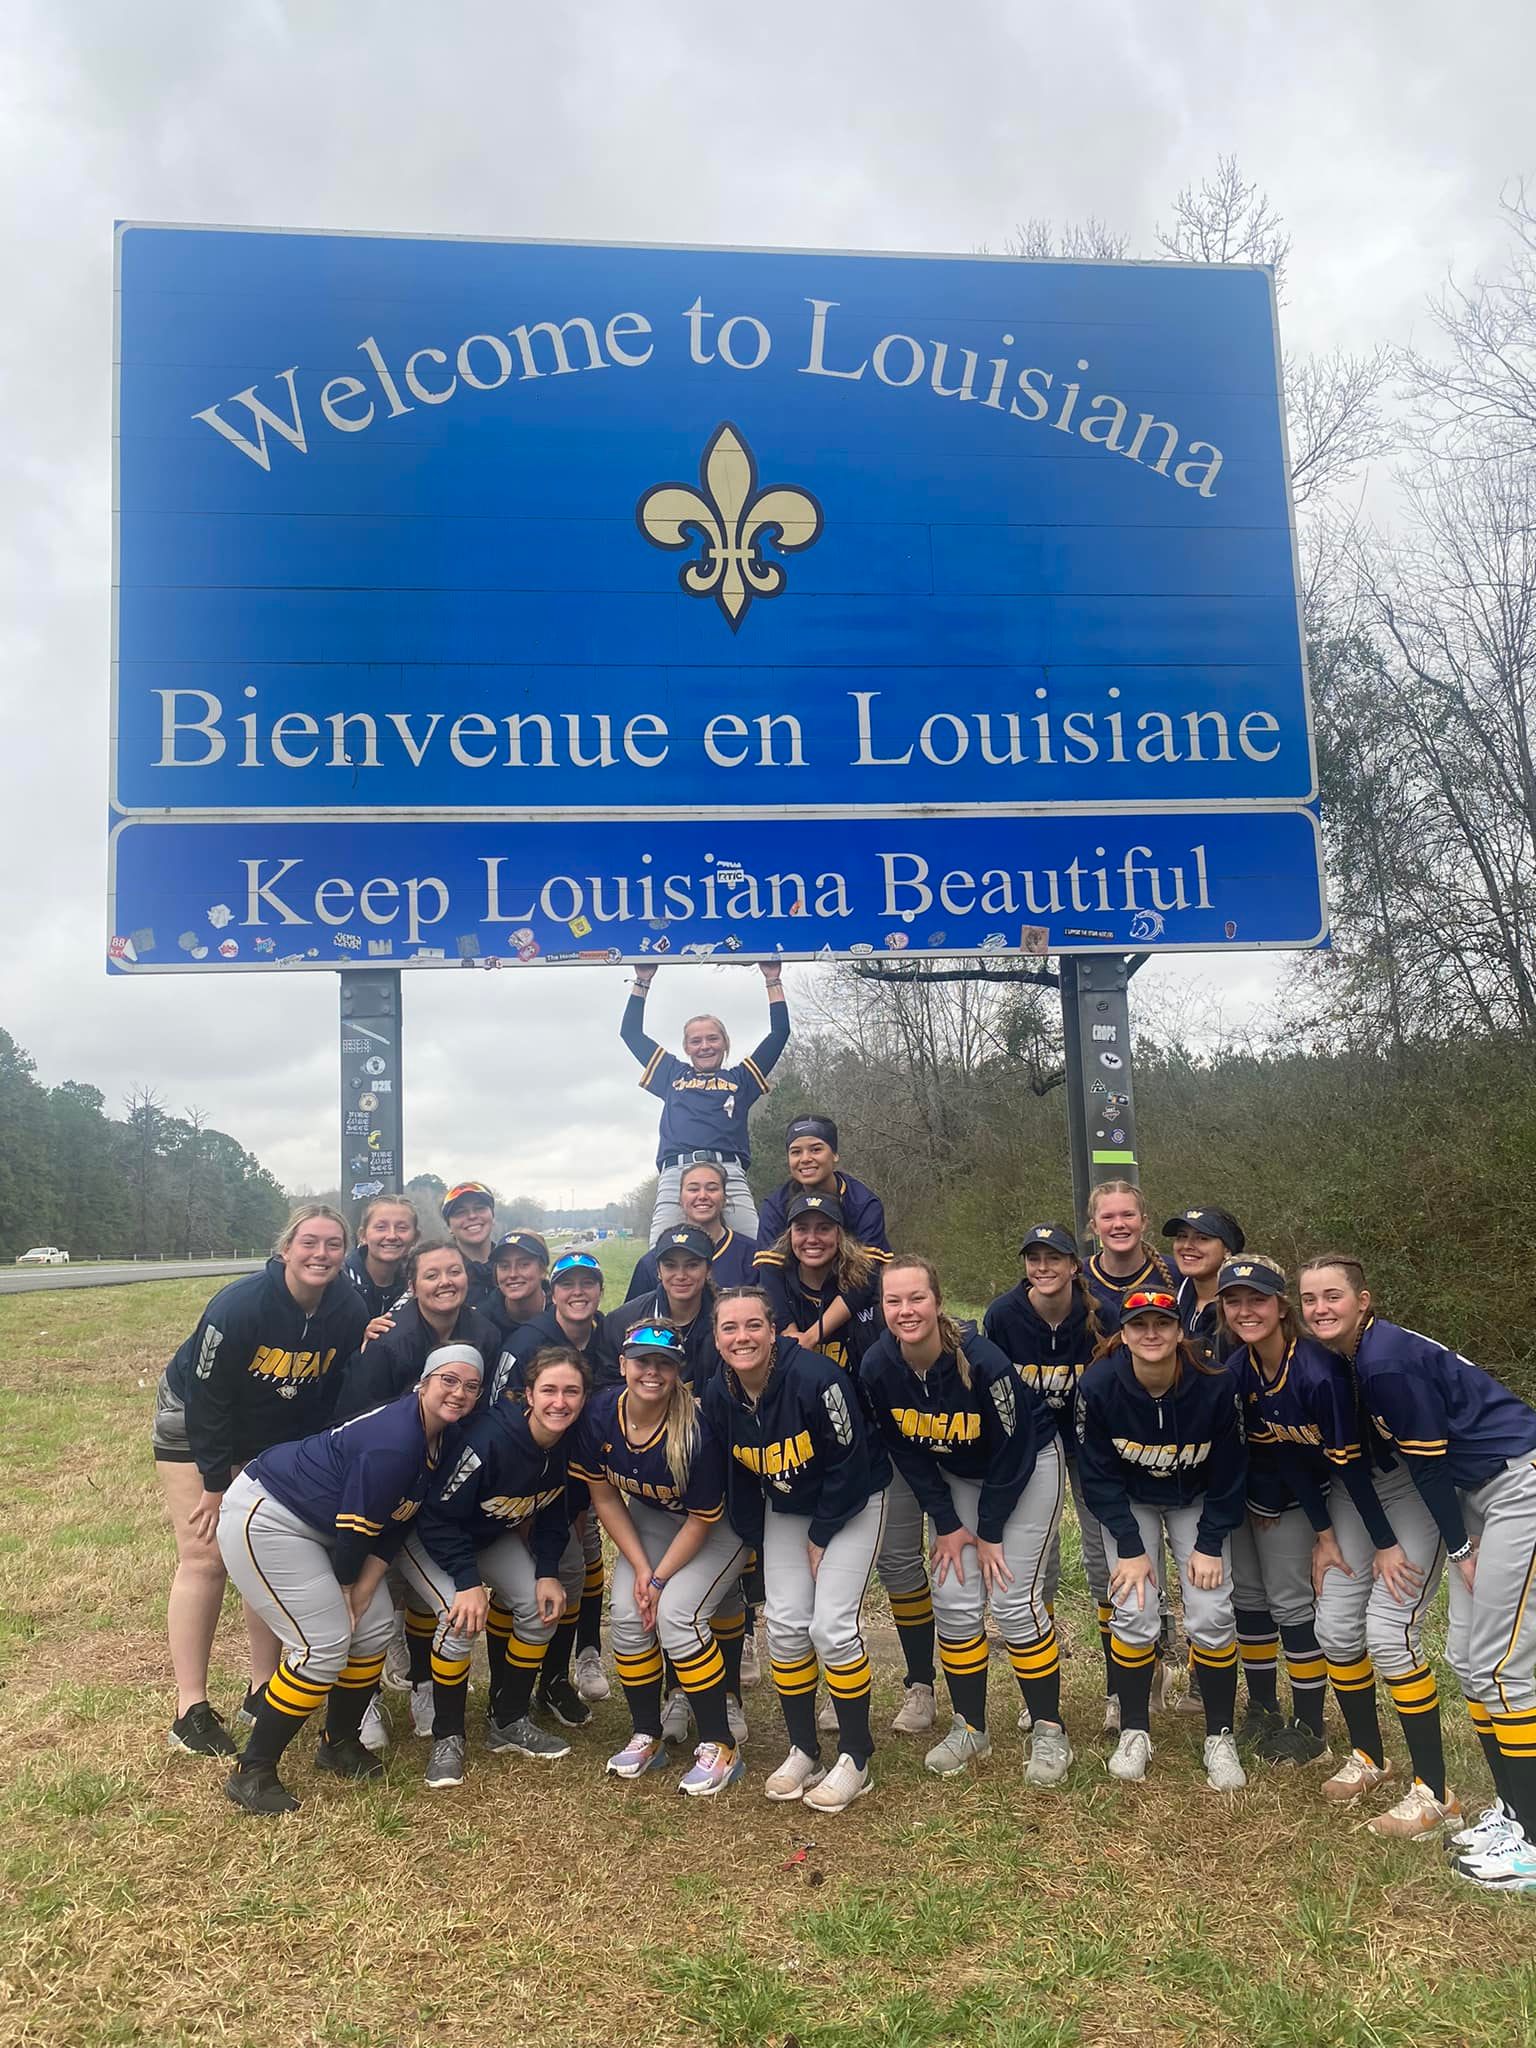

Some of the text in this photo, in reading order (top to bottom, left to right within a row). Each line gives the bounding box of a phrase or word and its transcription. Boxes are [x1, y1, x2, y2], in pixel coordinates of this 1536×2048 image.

[191, 296, 1224, 497] Welcome to Louisiana
[150, 686, 1281, 767] Bienvenue en Louisiane
[238, 845, 1216, 944] Keep Louisiana Beautiful
[723, 1095, 735, 1119] 4
[1233, 1266, 1254, 1277] W
[857, 1306, 874, 1322] W
